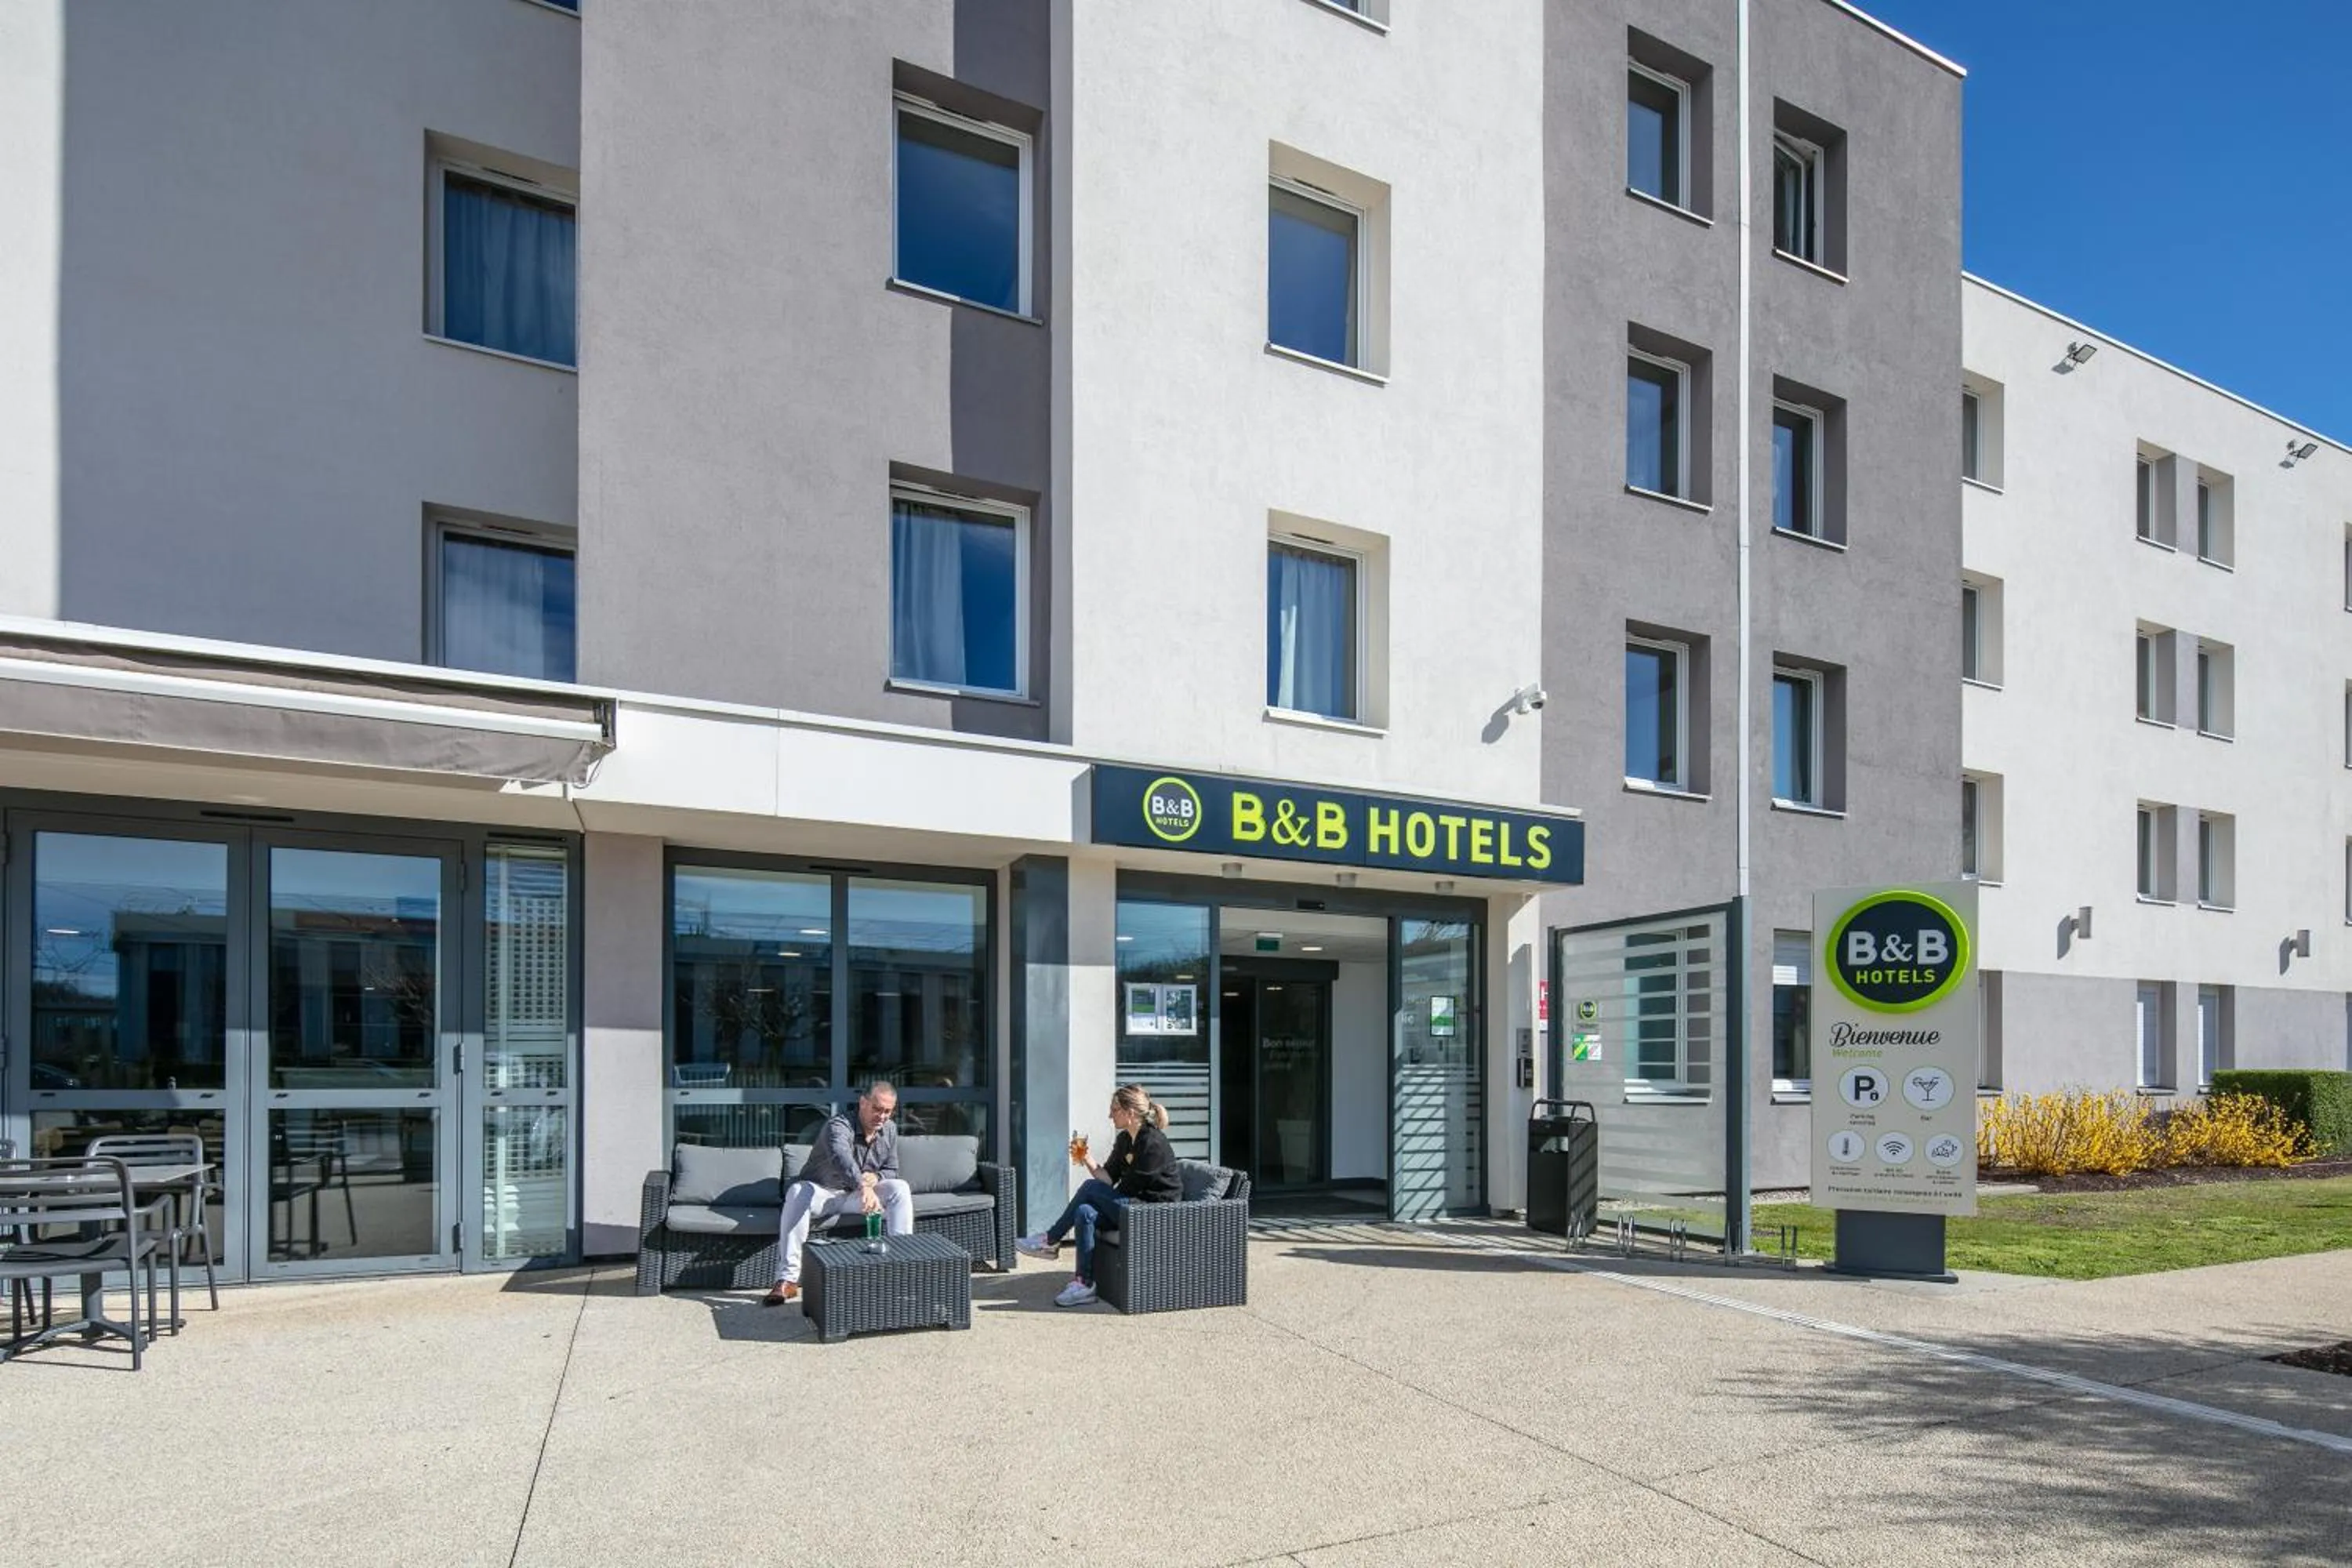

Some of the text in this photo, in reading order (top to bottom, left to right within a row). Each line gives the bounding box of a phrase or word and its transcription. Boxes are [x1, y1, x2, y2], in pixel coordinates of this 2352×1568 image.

[1152, 796, 1194, 818] B&B
[1156, 817, 1189, 827] HOTELS
[1232, 791, 1552, 870] B&B HOTELS
[1848, 929, 1948, 965] B&B
[1856, 969, 1935, 984] HOTELS
[1829, 1022, 1940, 1047] Bienvenue
[1832, 1049, 1882, 1058] Welcome
